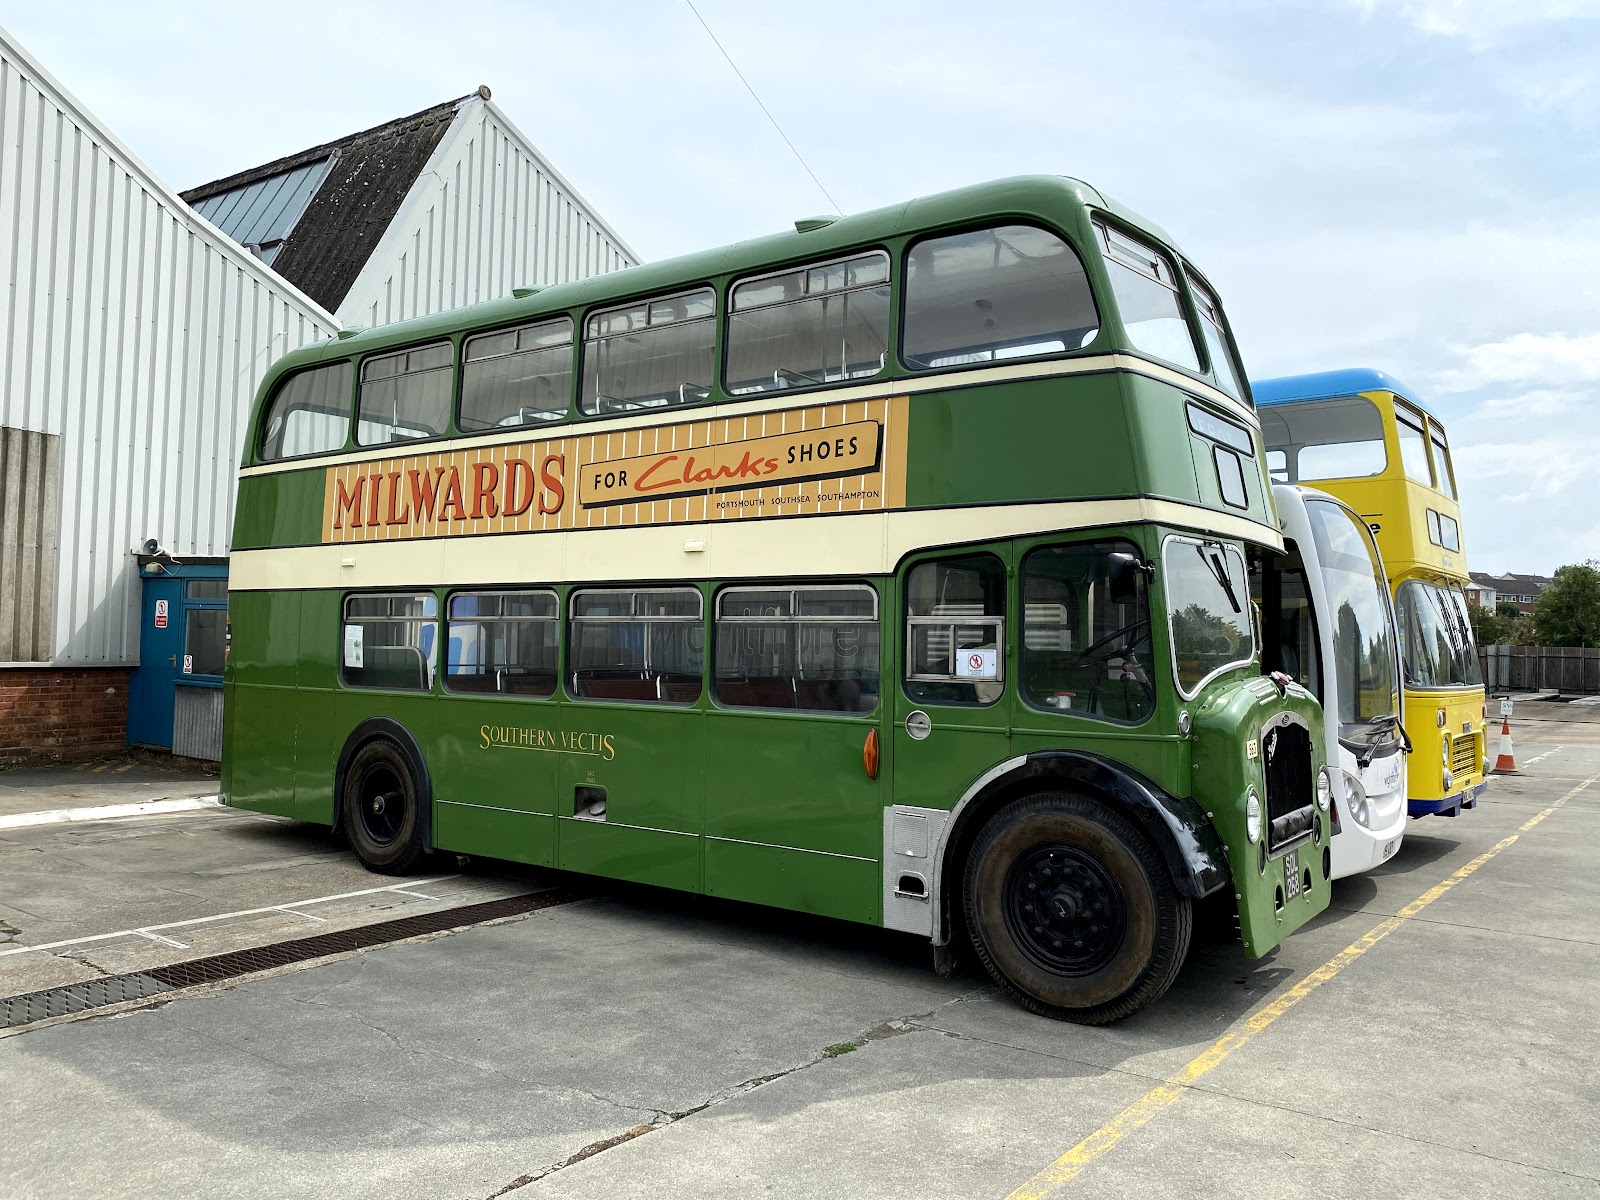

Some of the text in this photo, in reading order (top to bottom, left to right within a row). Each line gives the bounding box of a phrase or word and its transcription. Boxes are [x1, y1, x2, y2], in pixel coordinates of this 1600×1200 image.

[594, 436, 858, 492] FOR Clarks SHOES
[334, 453, 565, 529] MILWARDS
[716, 490, 880, 509] PORTSMOUTH SOUTHSEA SOUTHAMPTON
[479, 724, 616, 761] SOUTHERN VECTIS
[1285, 852, 1299, 876] SDL
[1287, 873, 1300, 899] 268
